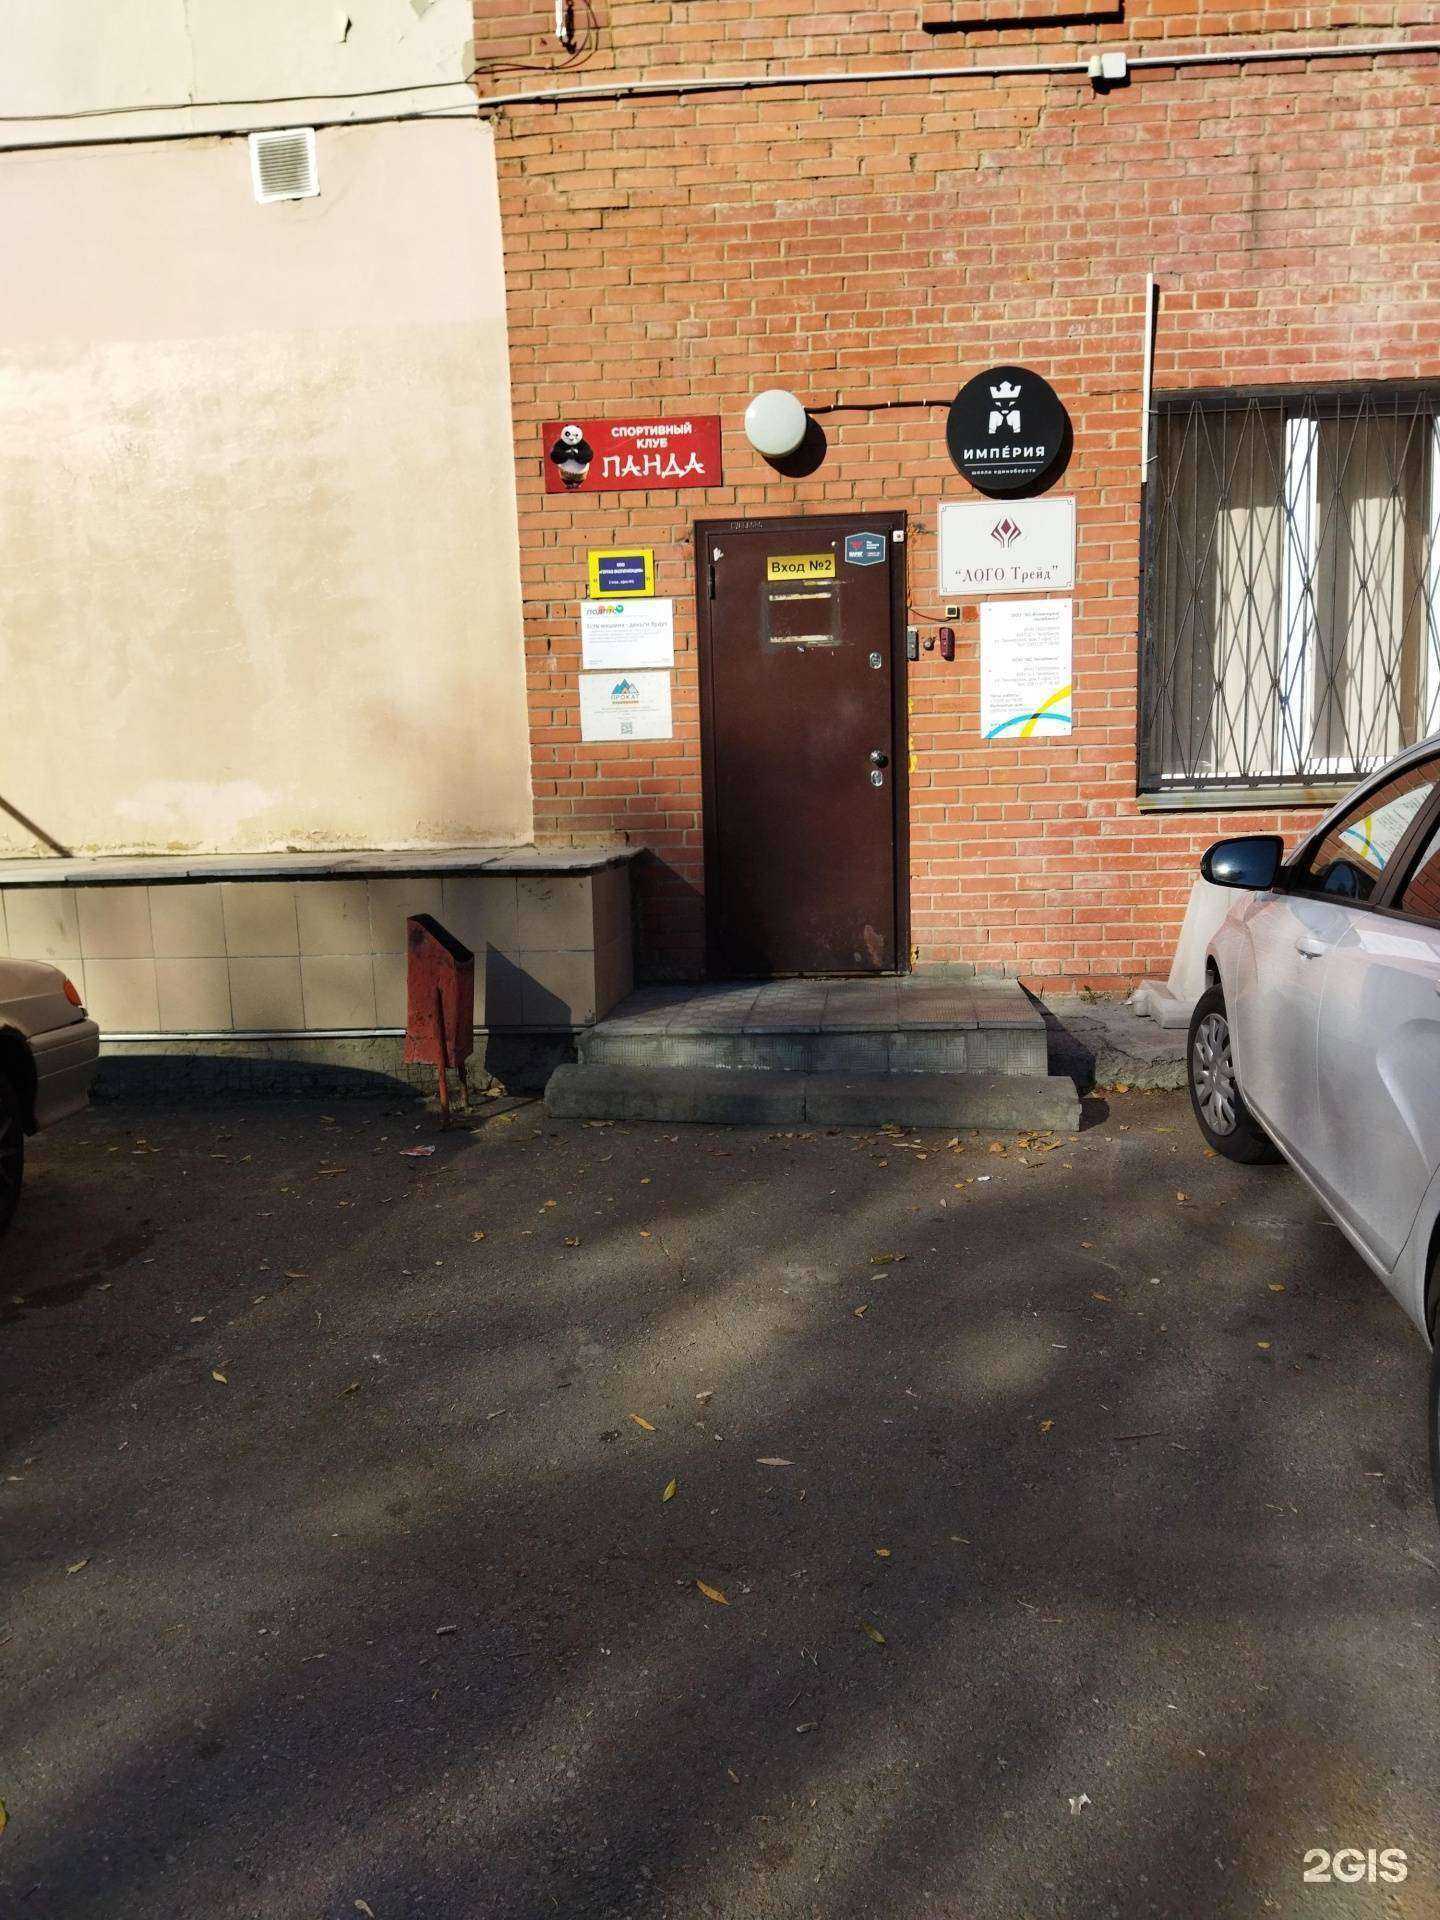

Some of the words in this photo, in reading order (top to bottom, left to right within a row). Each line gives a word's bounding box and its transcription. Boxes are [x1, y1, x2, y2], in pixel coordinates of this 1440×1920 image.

[611, 422, 692, 438] СПОРТИВНЫЙ
[636, 438, 668, 449] КЛУБ
[601, 452, 706, 479] ПАНДА
[771, 561, 805, 573] Вход
[809, 559, 832, 571] №2
